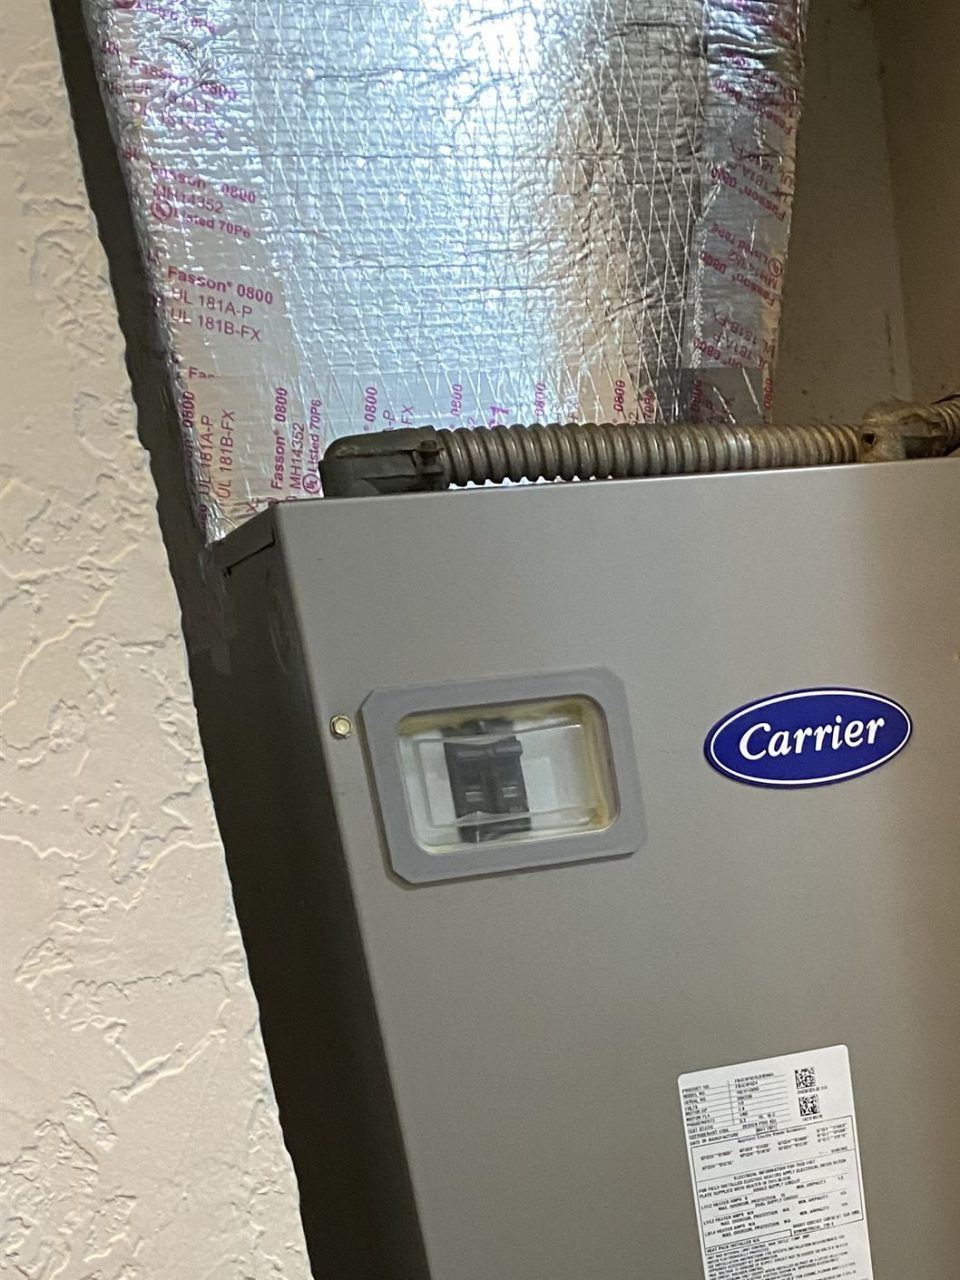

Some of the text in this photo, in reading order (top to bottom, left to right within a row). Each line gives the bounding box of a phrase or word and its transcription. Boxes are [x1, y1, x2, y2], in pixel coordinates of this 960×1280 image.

[199, 294, 253, 318] 181A-P
[237, 284, 273, 305] 0800
[171, 308, 261, 342] UL 181B-FX
[182, 391, 195, 428] 0800
[275, 387, 288, 422] 0800
[364, 386, 378, 423] 0800
[451, 383, 463, 417] 0800
[200, 415, 214, 469] 181A-P
[216, 409, 235, 499] UL 181B-FX
[289, 422, 305, 489] MH14352
[740, 715, 885, 760] Carrier
